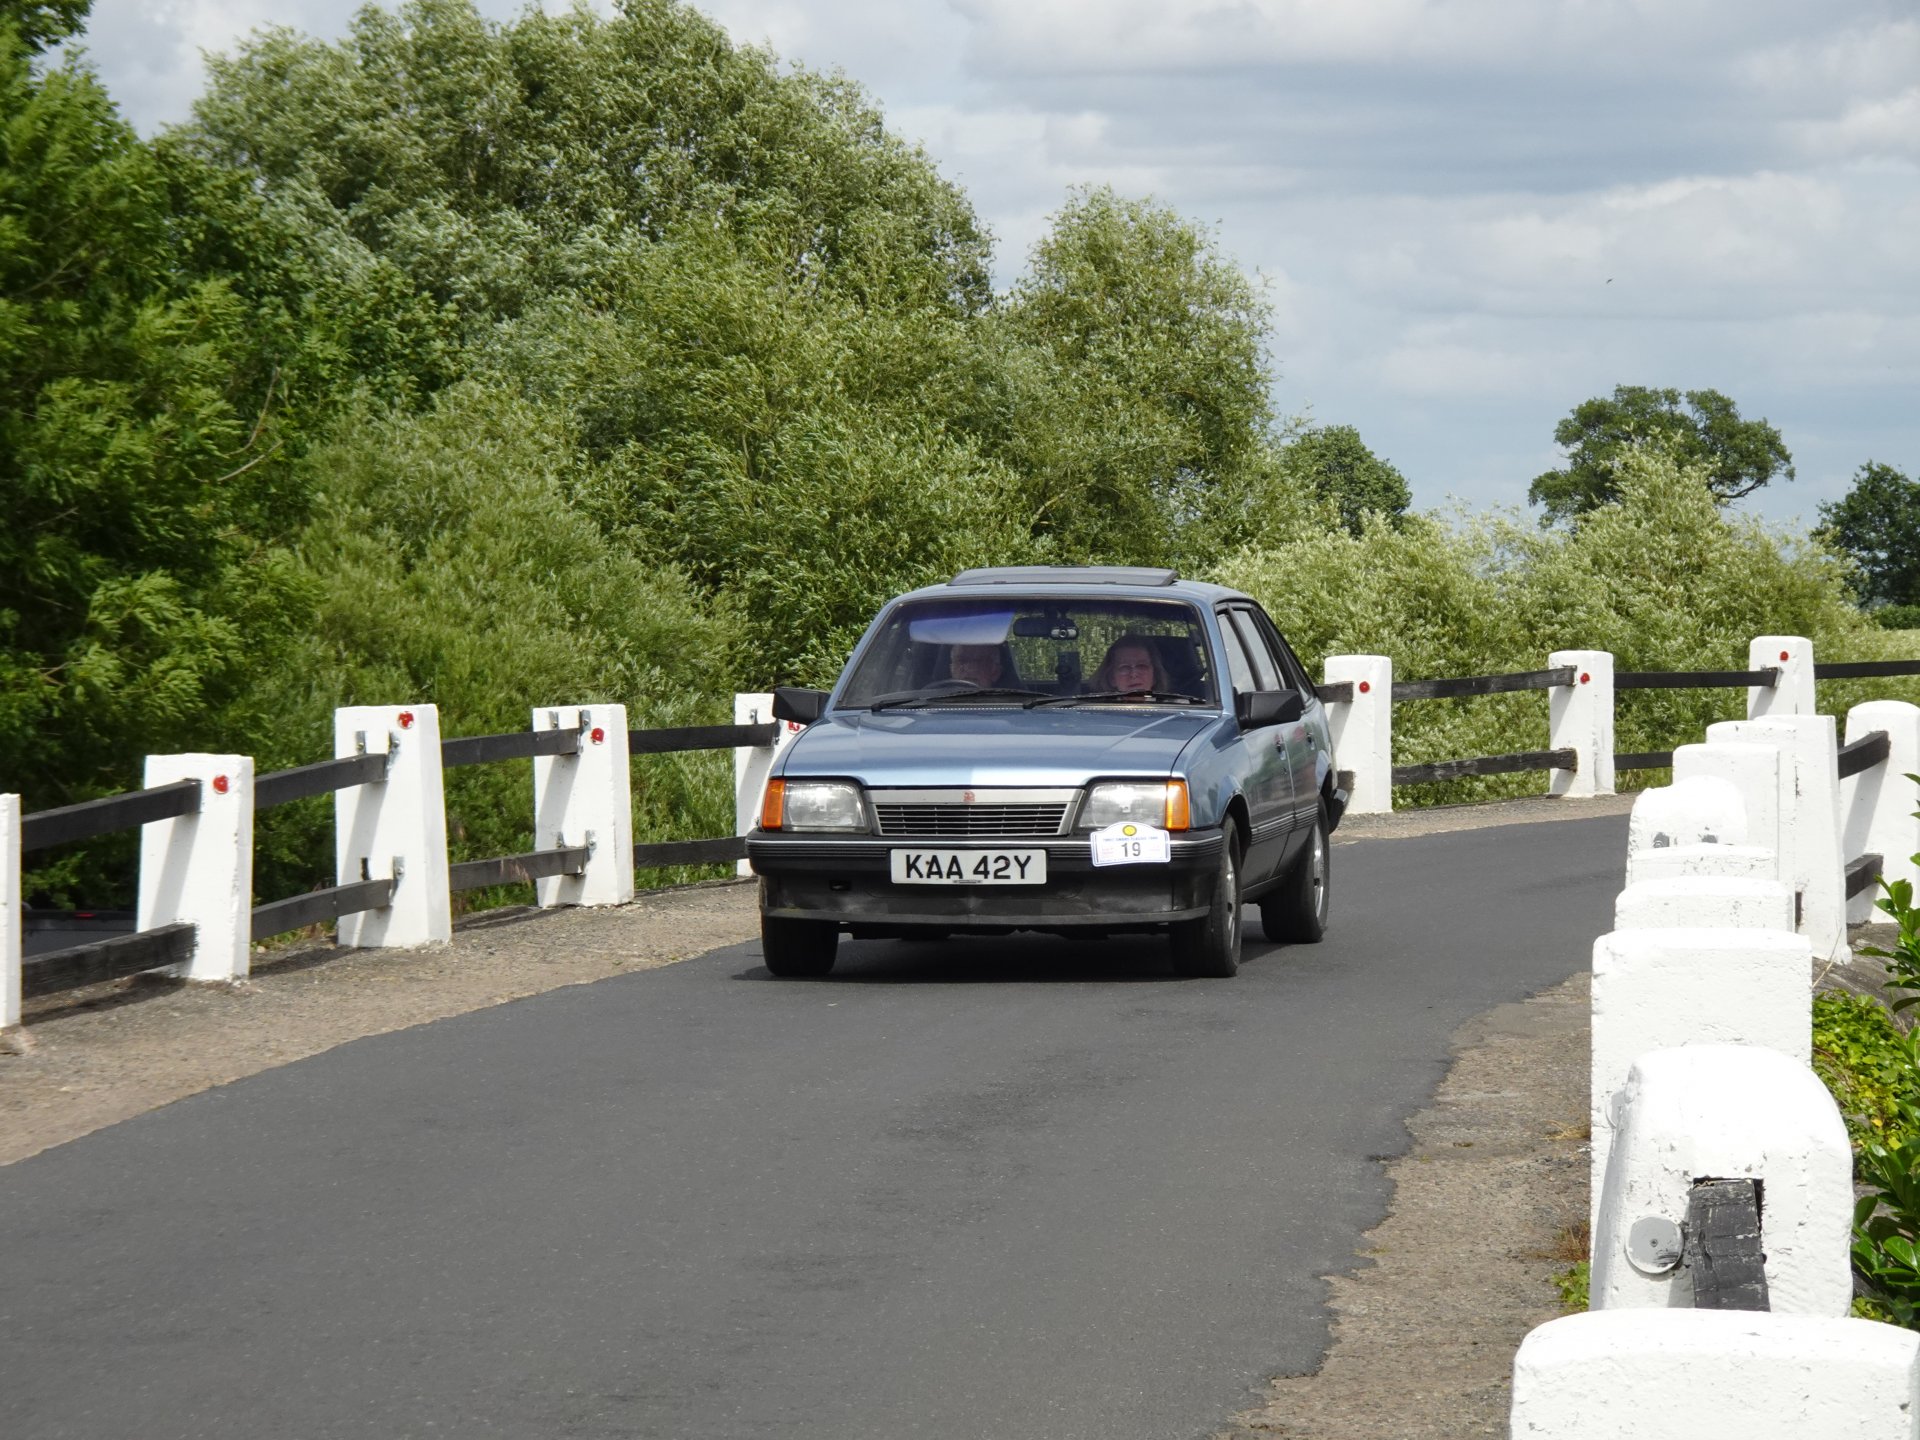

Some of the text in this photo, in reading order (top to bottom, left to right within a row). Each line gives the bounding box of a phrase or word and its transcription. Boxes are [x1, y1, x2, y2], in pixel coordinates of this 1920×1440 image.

[1121, 842, 1141, 857] 19
[906, 853, 1031, 880] KAA 42Y
